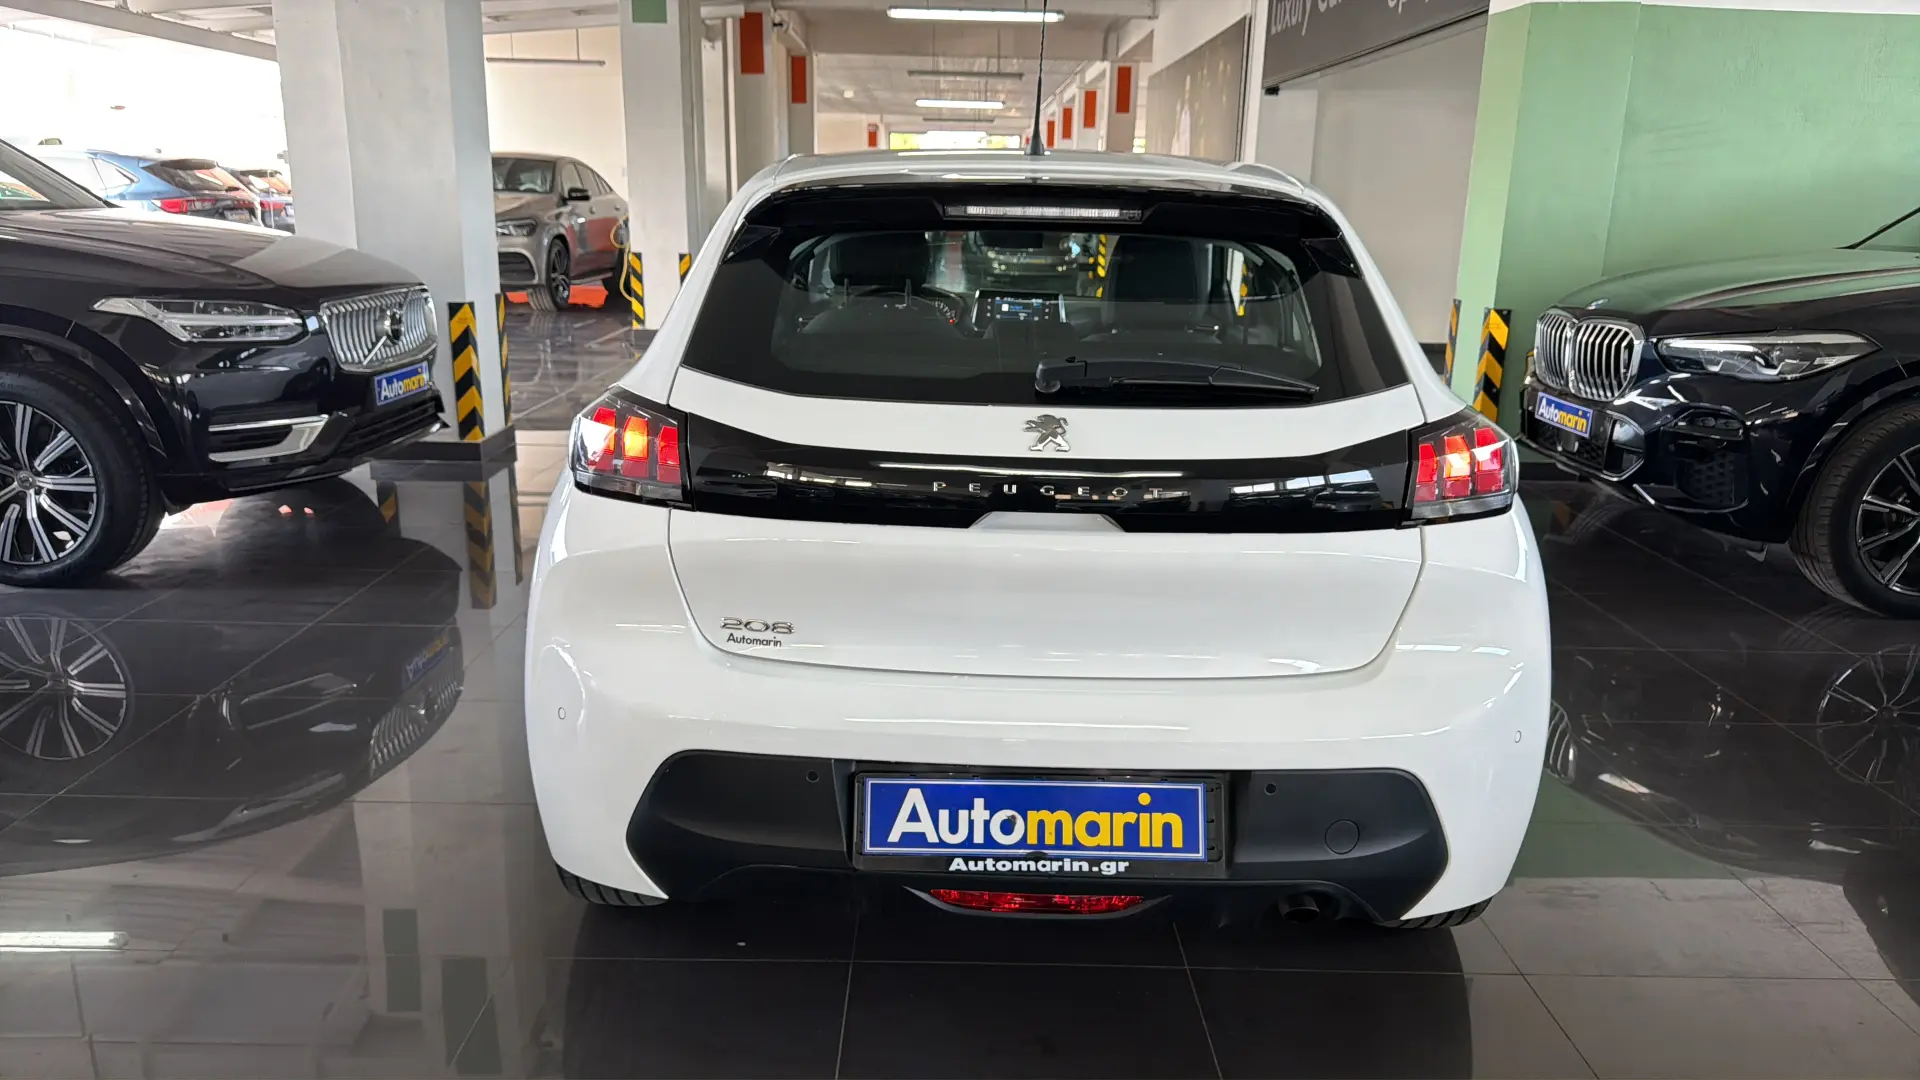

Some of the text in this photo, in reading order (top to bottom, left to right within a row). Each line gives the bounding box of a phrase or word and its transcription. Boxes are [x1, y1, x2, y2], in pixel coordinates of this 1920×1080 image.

[1538, 397, 1587, 432] Automarin
[933, 481, 1163, 498] PEUGEOT
[720, 617, 795, 634] 208
[726, 632, 782, 647] Automarin
[887, 788, 1183, 848] Automarin
[949, 857, 1129, 875] Automarin.gr
